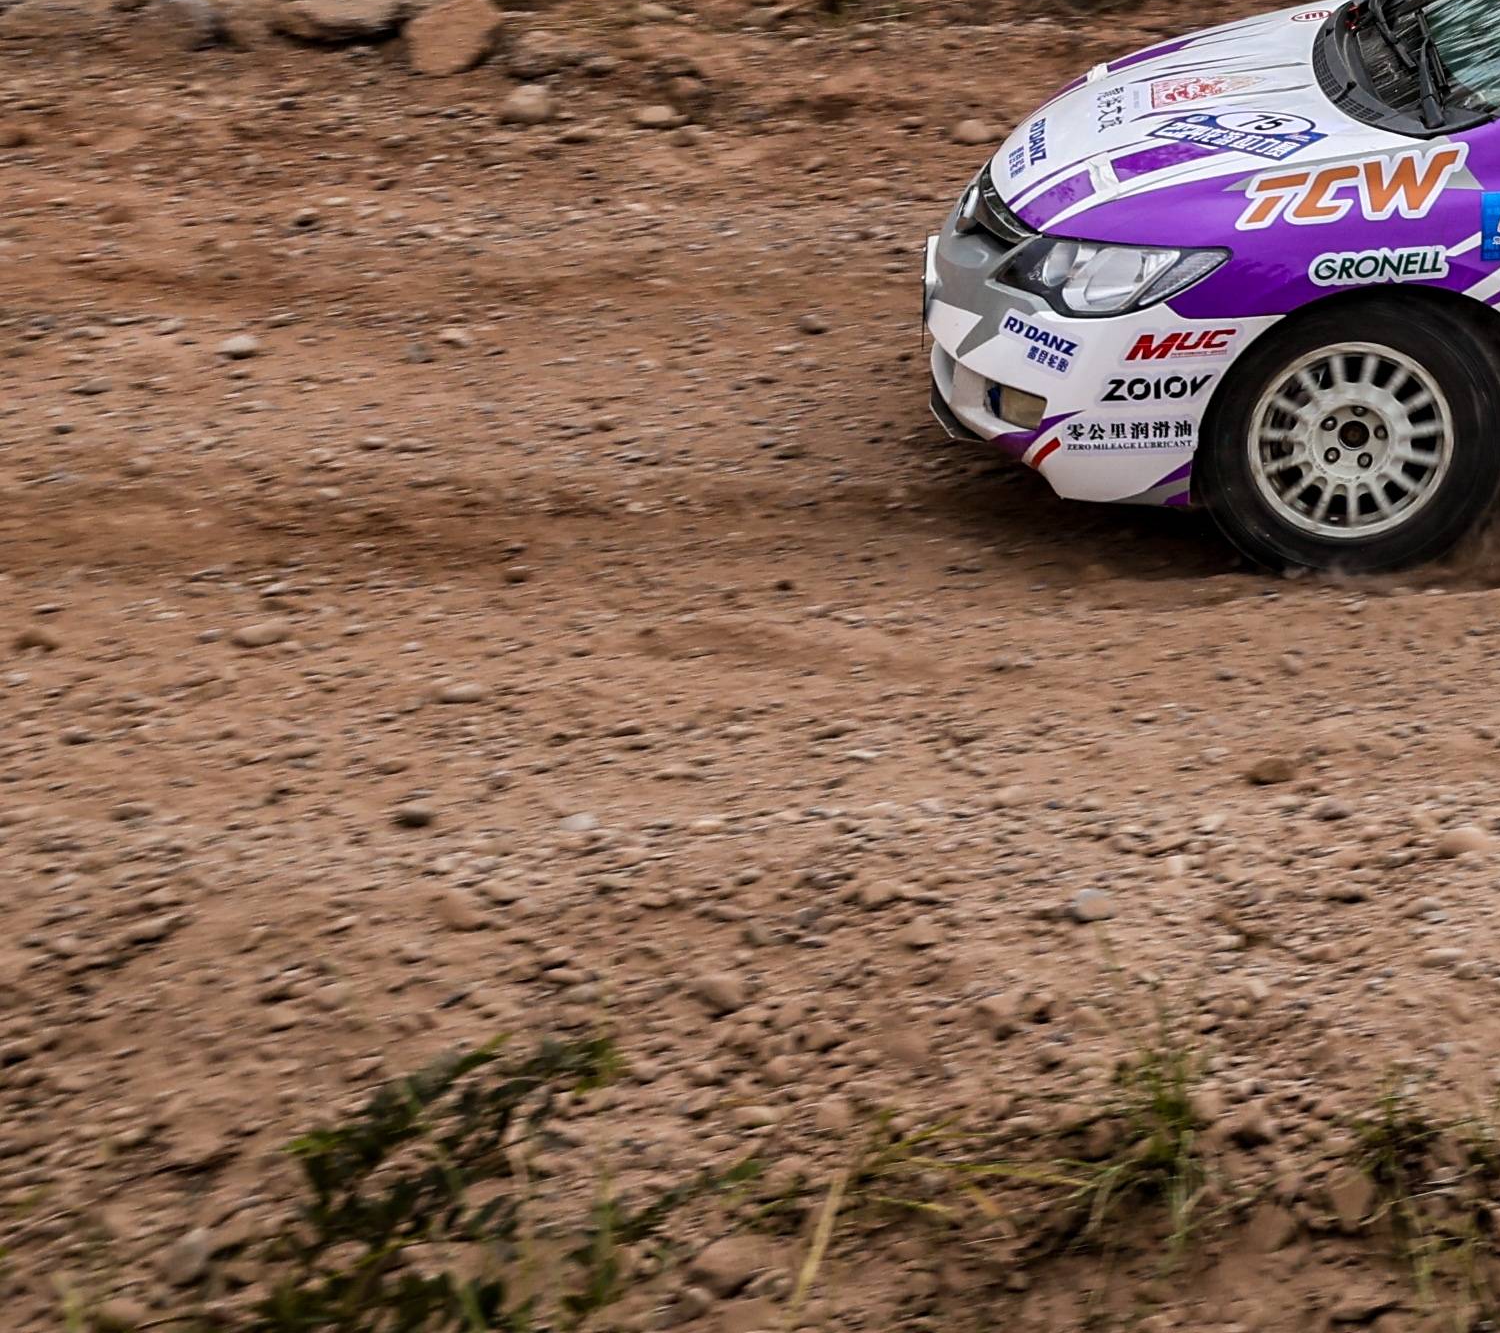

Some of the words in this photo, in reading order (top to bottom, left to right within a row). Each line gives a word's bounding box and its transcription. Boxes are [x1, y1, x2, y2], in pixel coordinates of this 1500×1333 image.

[1237, 113, 1294, 131] 75
[1243, 149, 1460, 225] TCW
[1313, 251, 1443, 280] GRONELL
[1003, 316, 1078, 357] RYDANZ
[1125, 329, 1237, 361] MUC
[1066, 420, 1193, 441] 零公里润滑油
[1066, 443, 1092, 451] ZERO
[1093, 441, 1136, 451] MILEAGE
[1138, 439, 1193, 450] LUBRICANT
